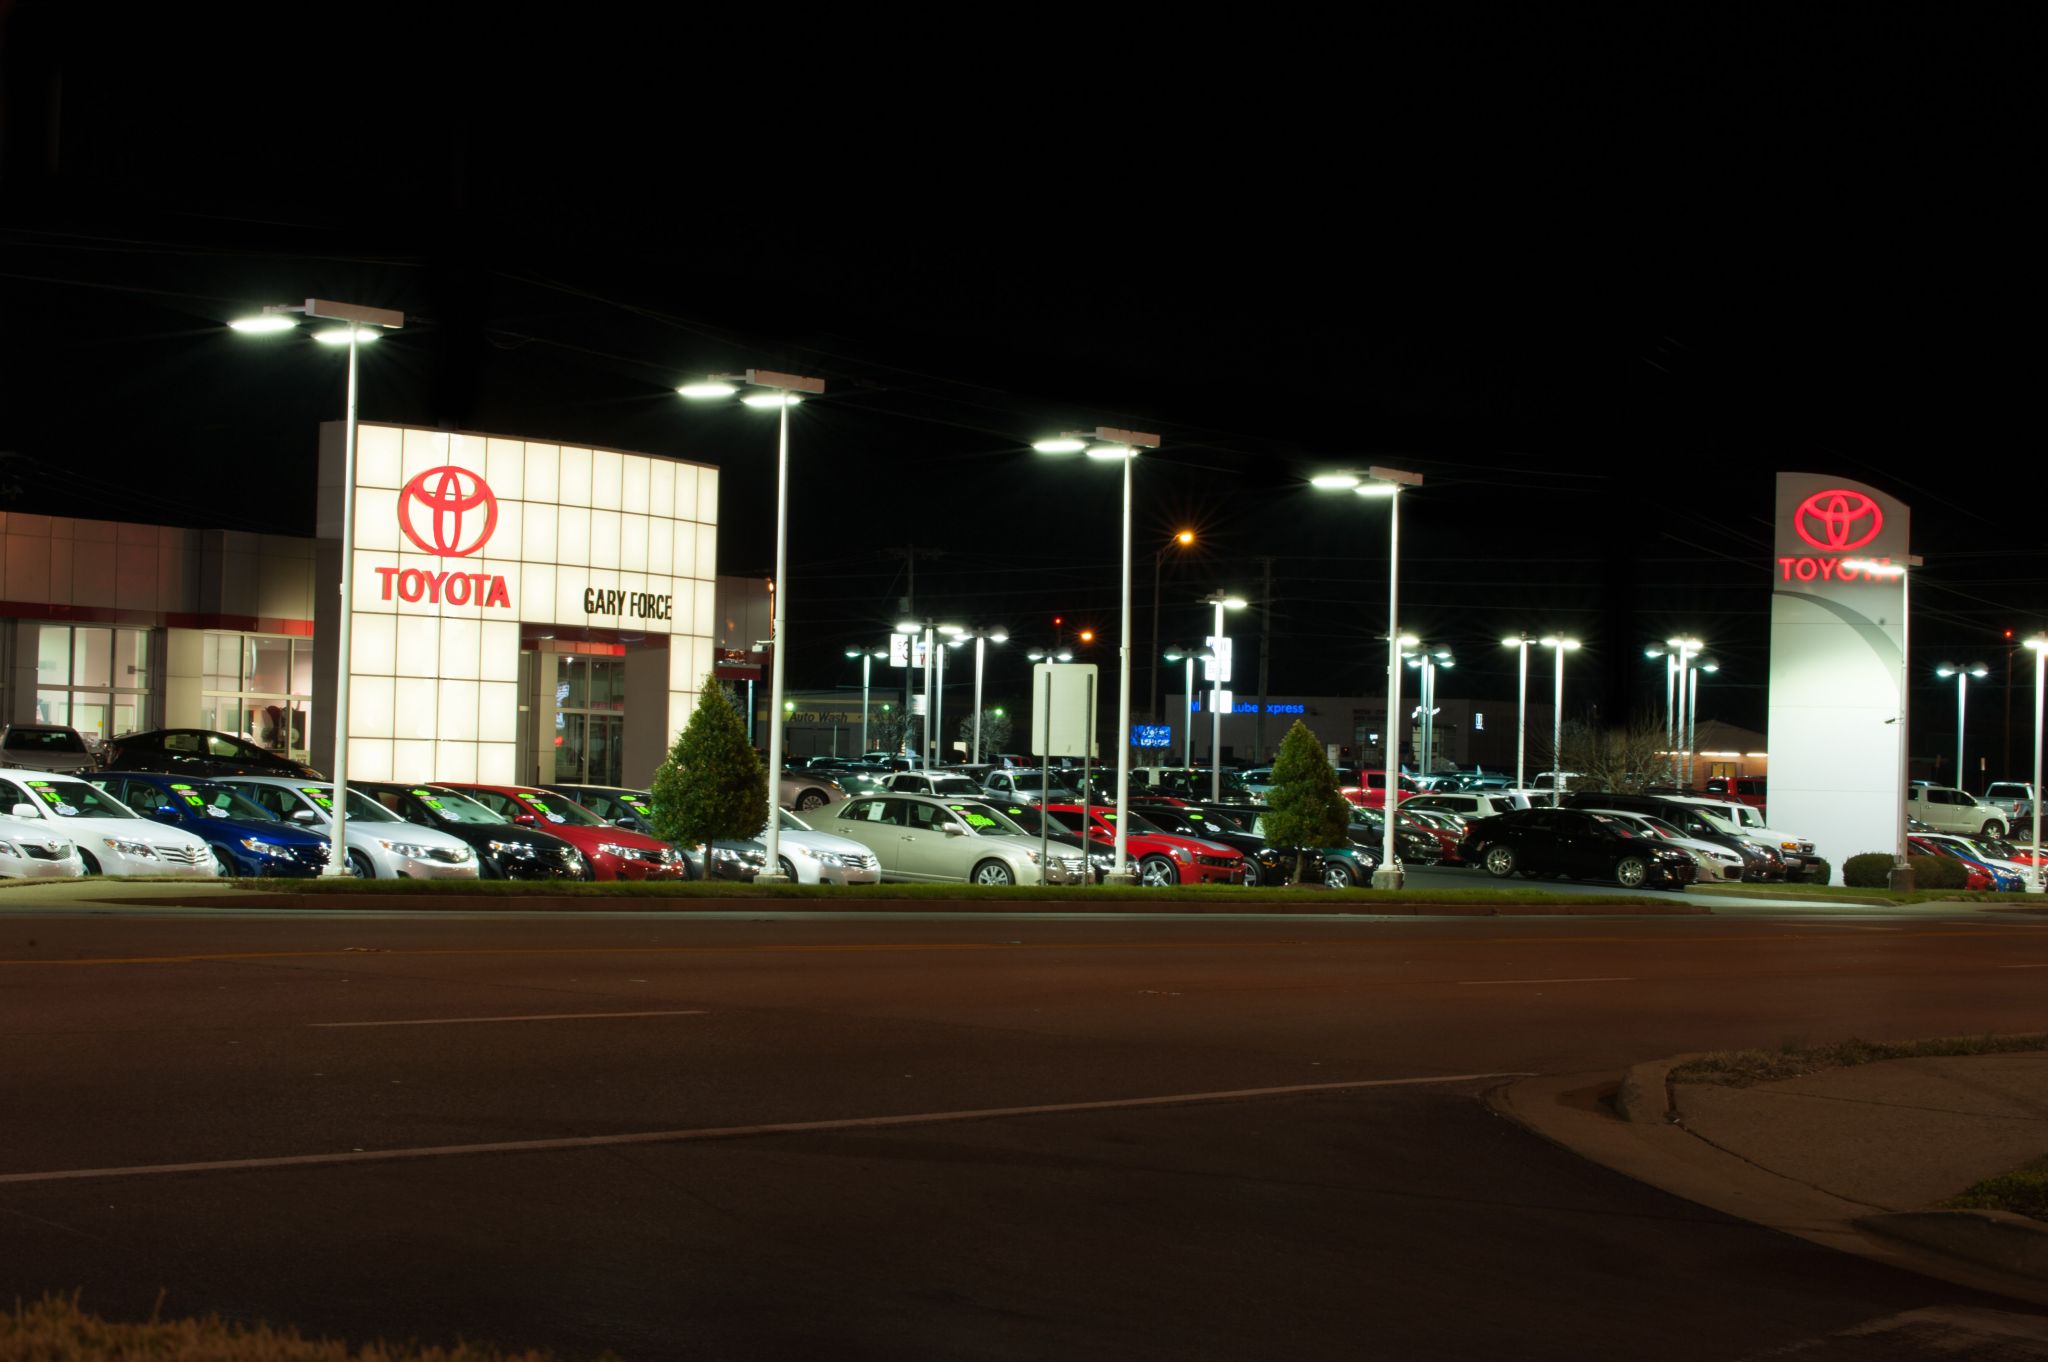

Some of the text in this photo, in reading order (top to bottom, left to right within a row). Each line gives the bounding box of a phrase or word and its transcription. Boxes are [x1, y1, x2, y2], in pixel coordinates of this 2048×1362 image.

[375, 567, 511, 608] TOYOTA
[583, 587, 672, 620] GARY FORCE
[789, 711, 848, 723] Auto Wash
[1232, 702, 1304, 717] Lube xpress
